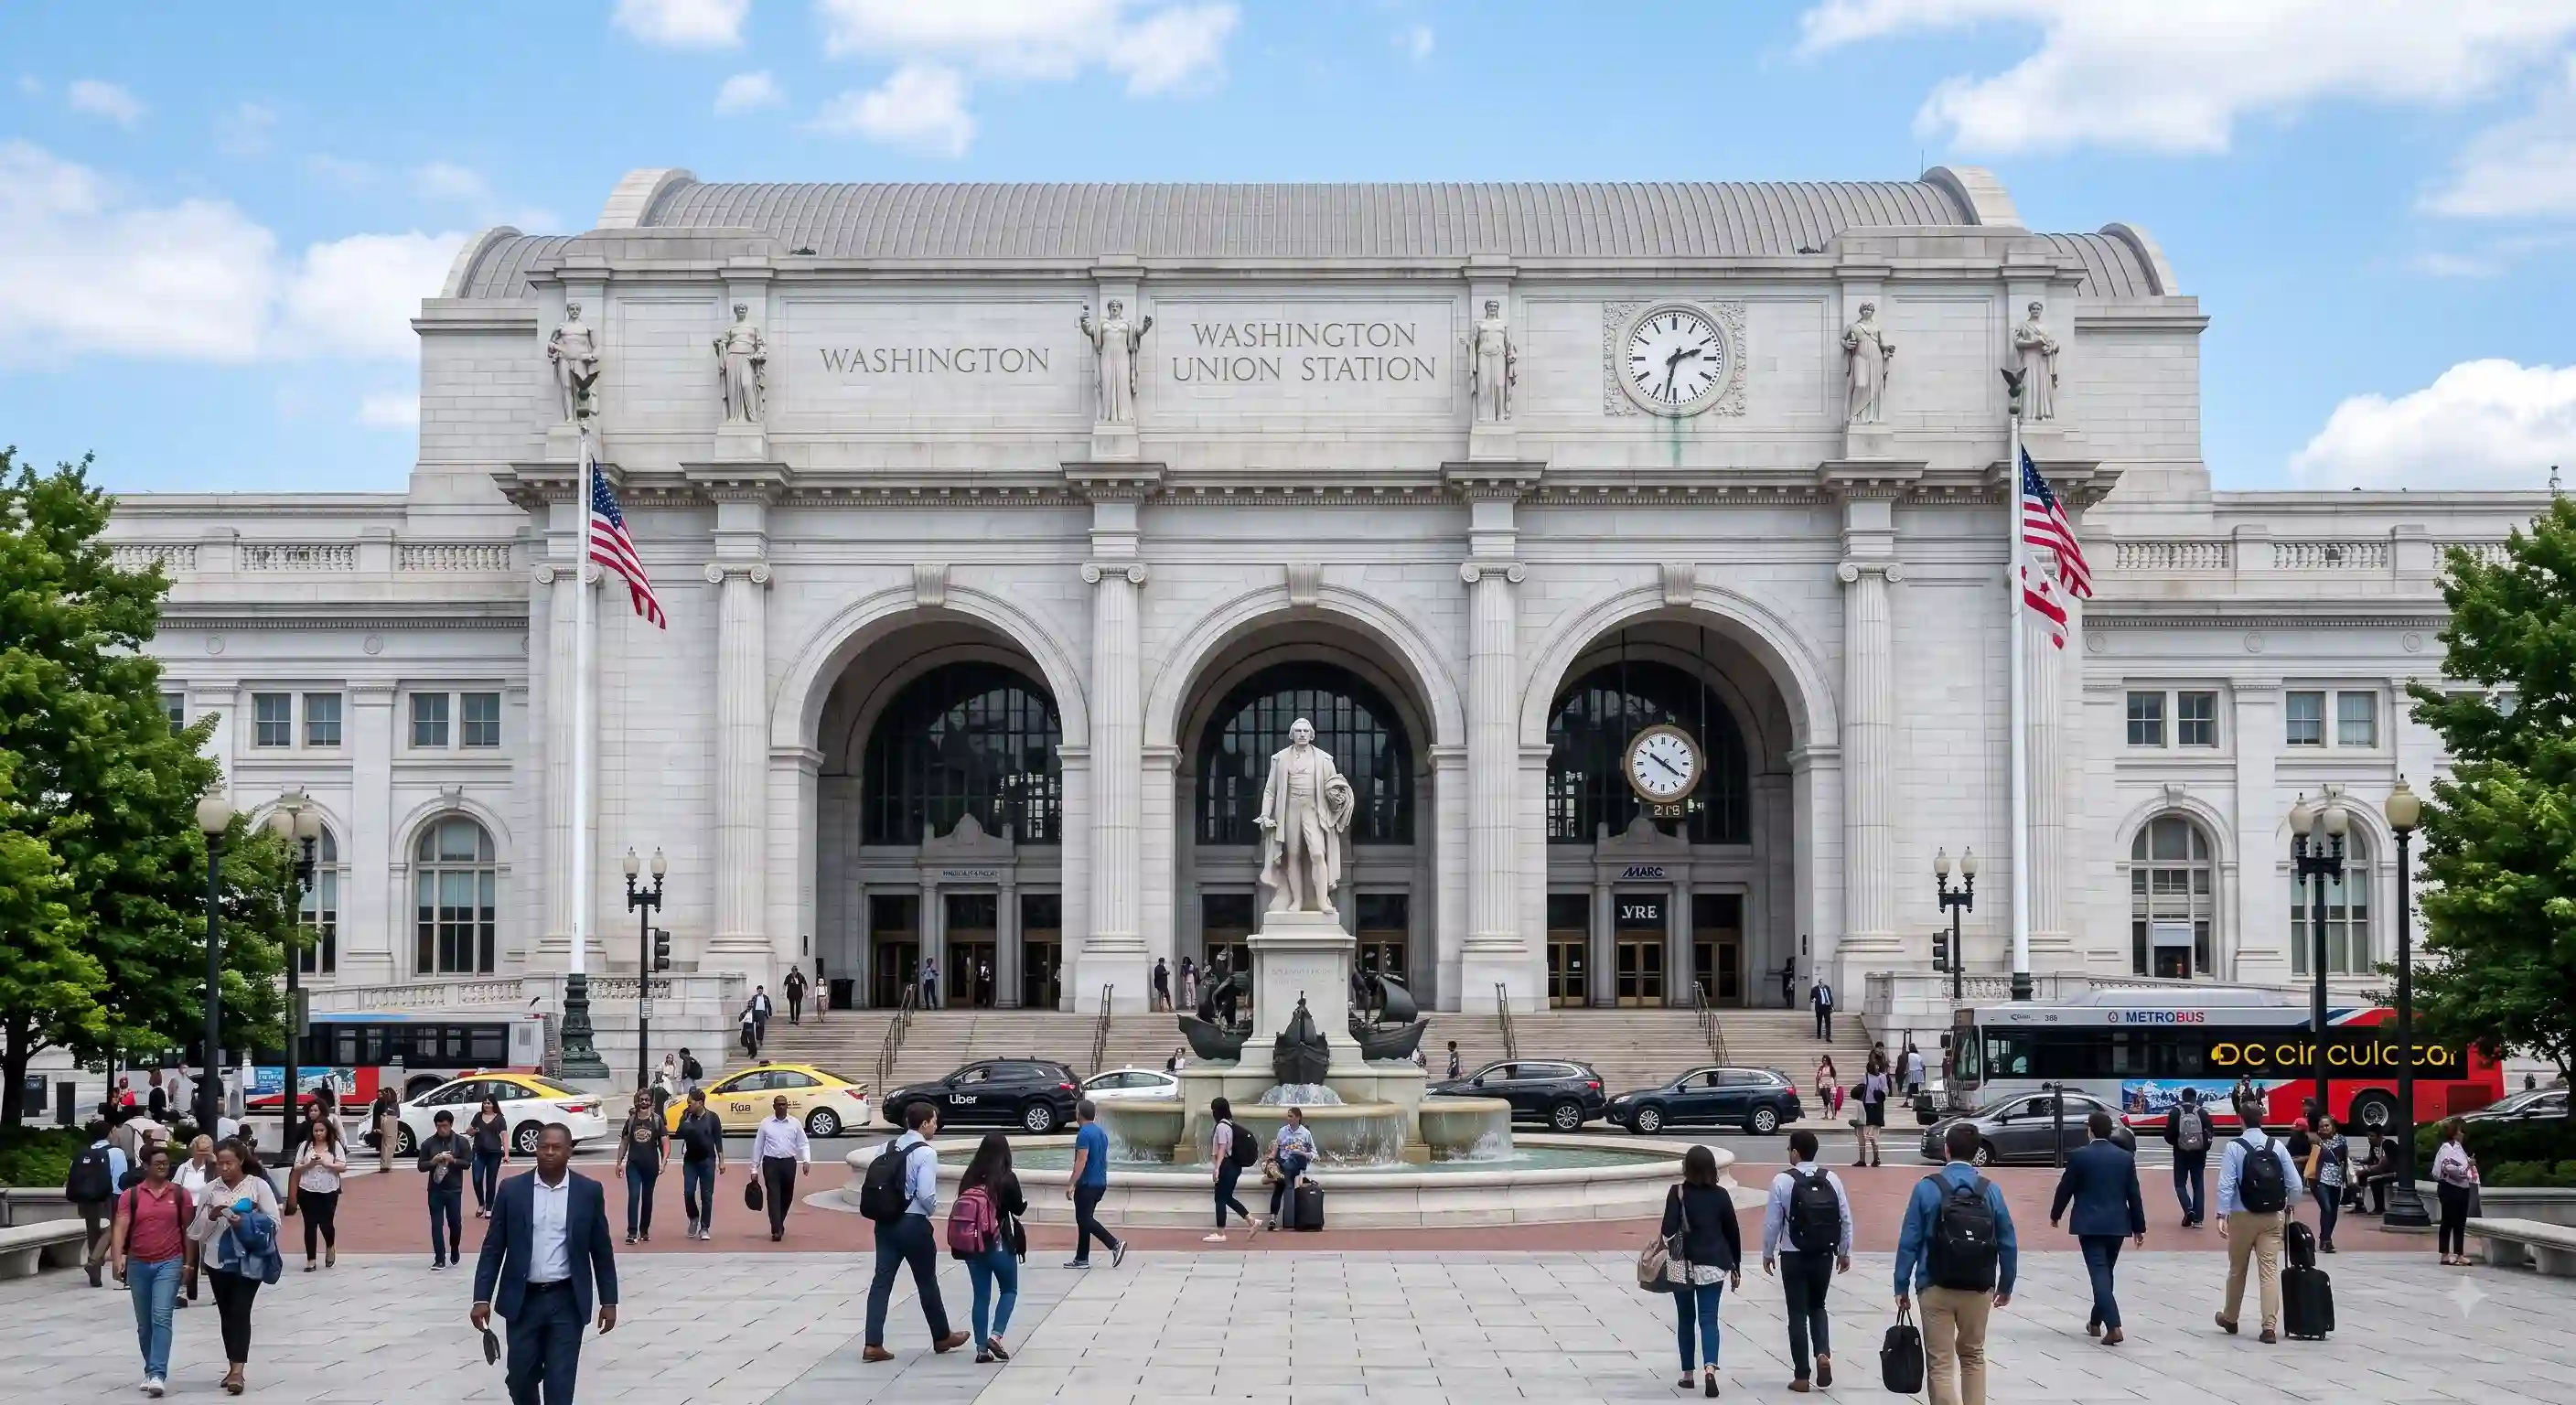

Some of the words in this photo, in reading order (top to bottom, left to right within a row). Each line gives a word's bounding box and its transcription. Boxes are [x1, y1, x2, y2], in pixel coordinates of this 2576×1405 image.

[1191, 322, 1417, 349] WASHINGTON
[820, 348, 1050, 374] WASHINGTON
[1173, 356, 1282, 382] UNION
[1301, 356, 1436, 382] STATION
[1622, 866, 1665, 878] MARC
[1622, 906, 1658, 919] VRE
[2126, 1011, 2205, 1023] METROBUS
[950, 1094, 978, 1105] Uber
